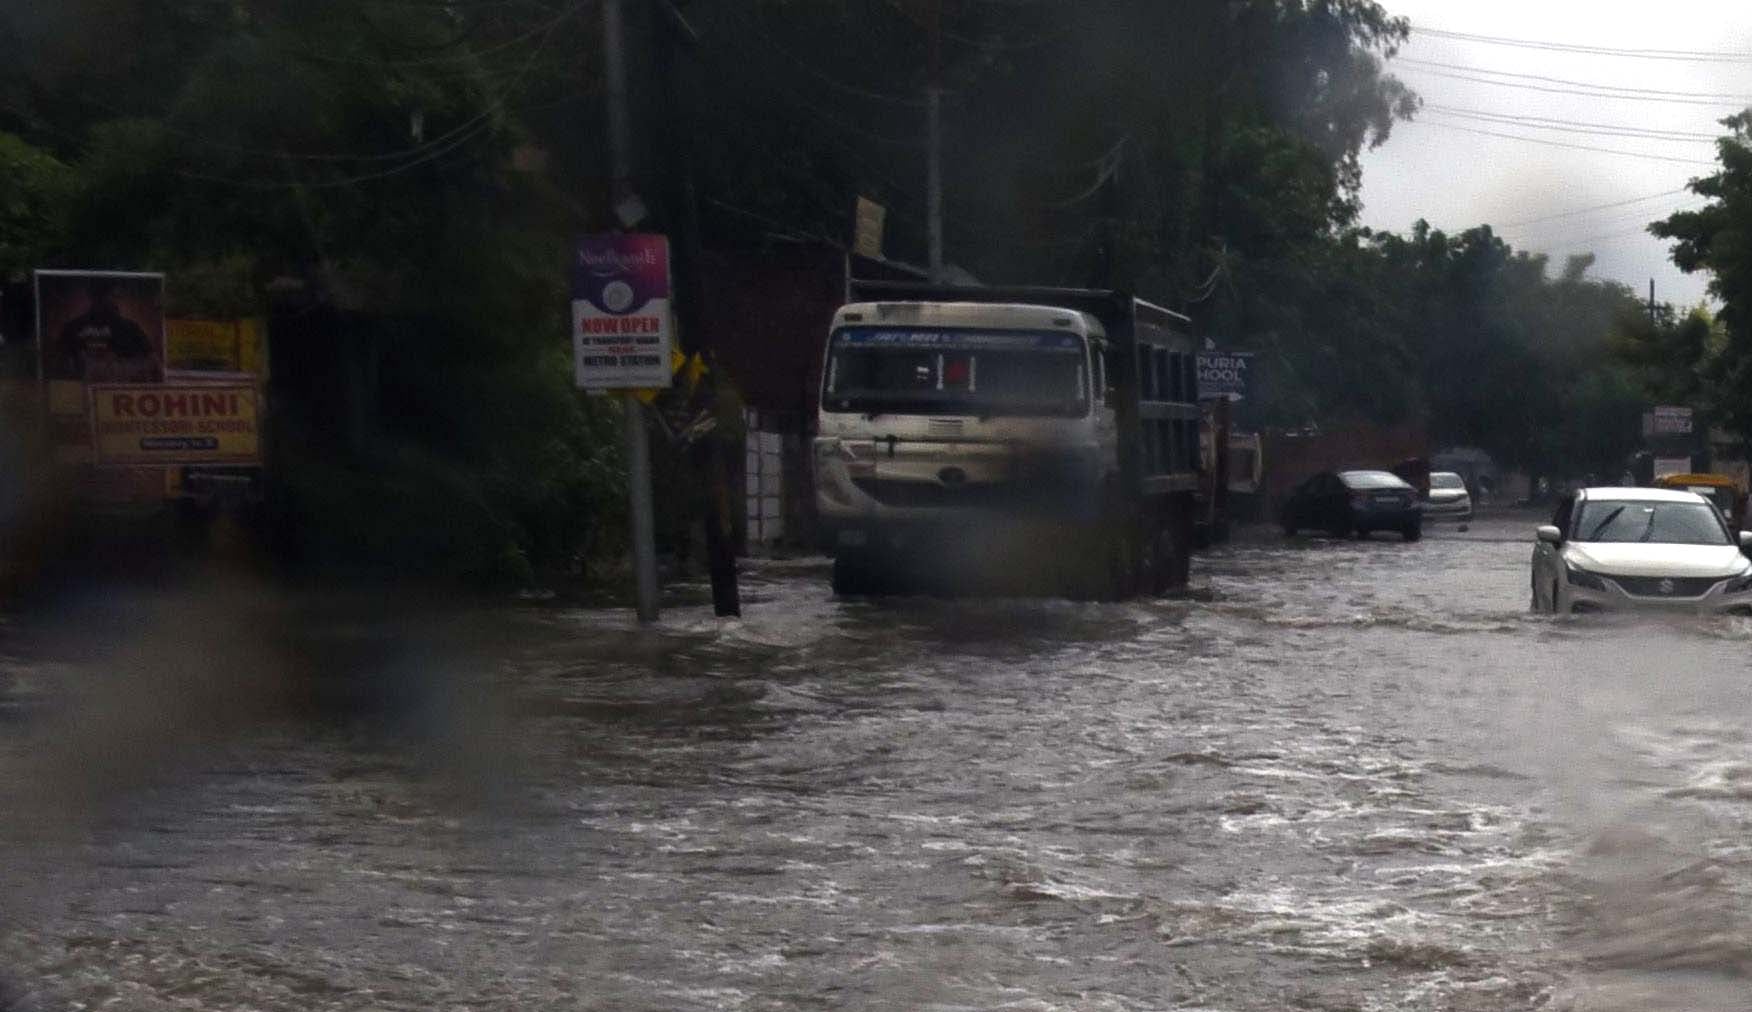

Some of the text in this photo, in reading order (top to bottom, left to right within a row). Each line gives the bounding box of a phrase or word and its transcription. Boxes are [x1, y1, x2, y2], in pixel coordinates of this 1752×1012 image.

[582, 317, 660, 333] NOW OPEN
[1197, 357, 1247, 369] PURIA
[1197, 369, 1242, 381] HOOL
[112, 393, 239, 417] ROHINI
